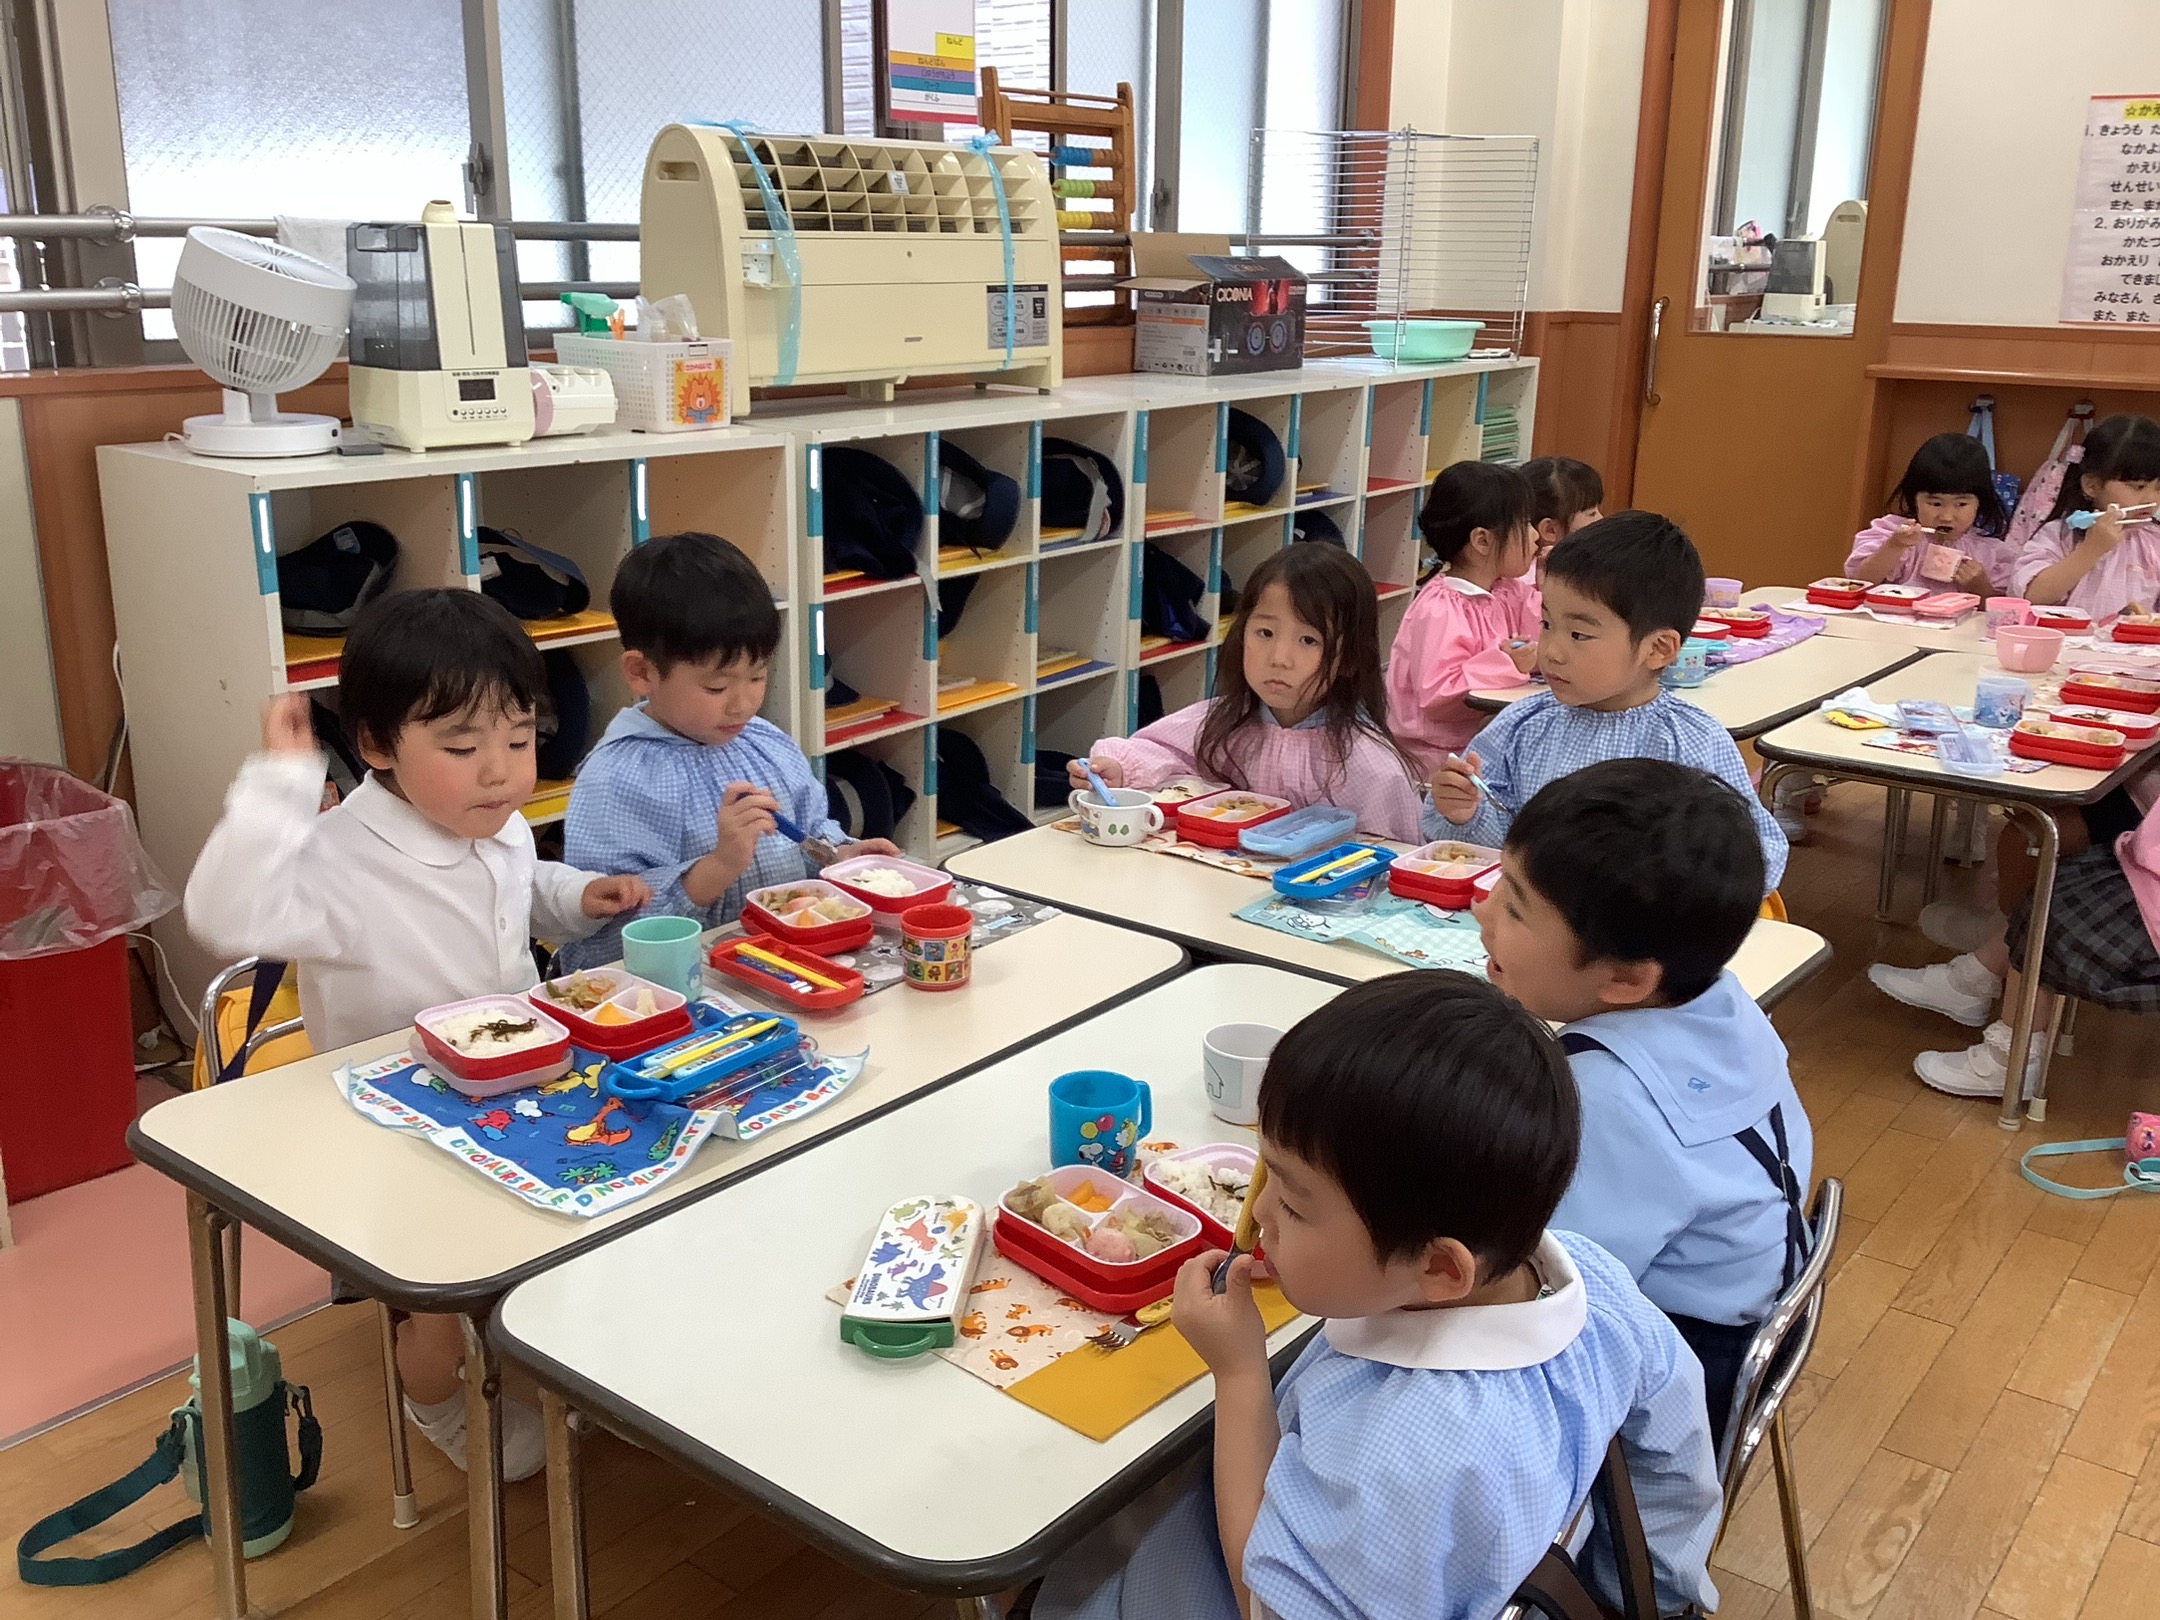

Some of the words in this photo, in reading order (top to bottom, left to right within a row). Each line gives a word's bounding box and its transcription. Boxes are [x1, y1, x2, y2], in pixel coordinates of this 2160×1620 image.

[2099, 123, 2144, 137] きょうも
[2100, 254, 2150, 267] おかえり
[2093, 291, 2144, 304] みなさん
[2092, 309, 2117, 321] また
[2126, 310, 2150, 322] また
